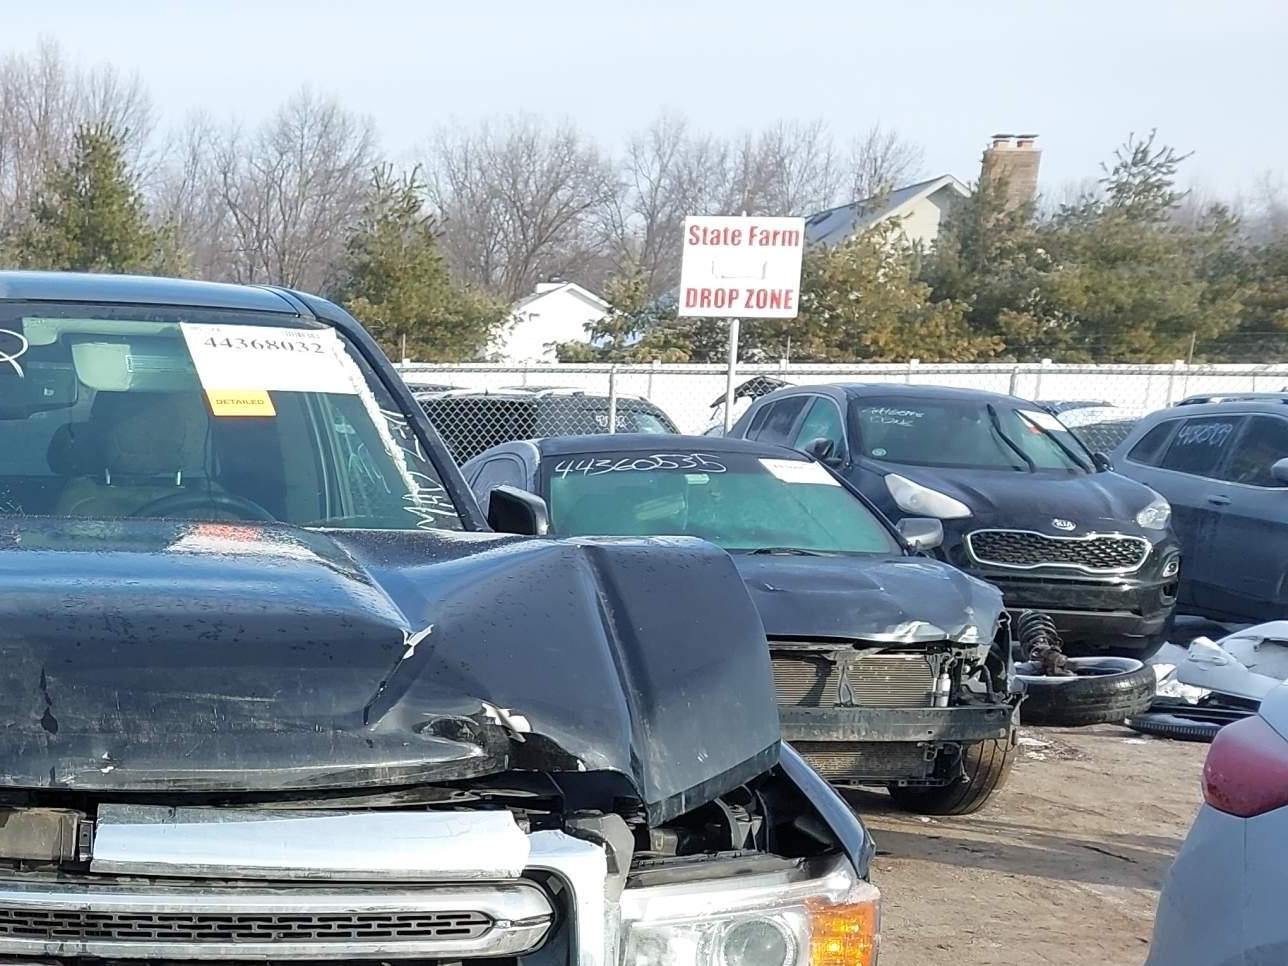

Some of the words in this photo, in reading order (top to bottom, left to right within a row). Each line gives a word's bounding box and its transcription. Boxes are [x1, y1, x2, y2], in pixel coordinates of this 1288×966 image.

[688, 224, 742, 246] State
[748, 225, 800, 247] Farm
[685, 287, 740, 309] DROP
[744, 288, 794, 310] ZONE
[203, 336, 326, 354] 44368032
[555, 453, 727, 479] 44360535
